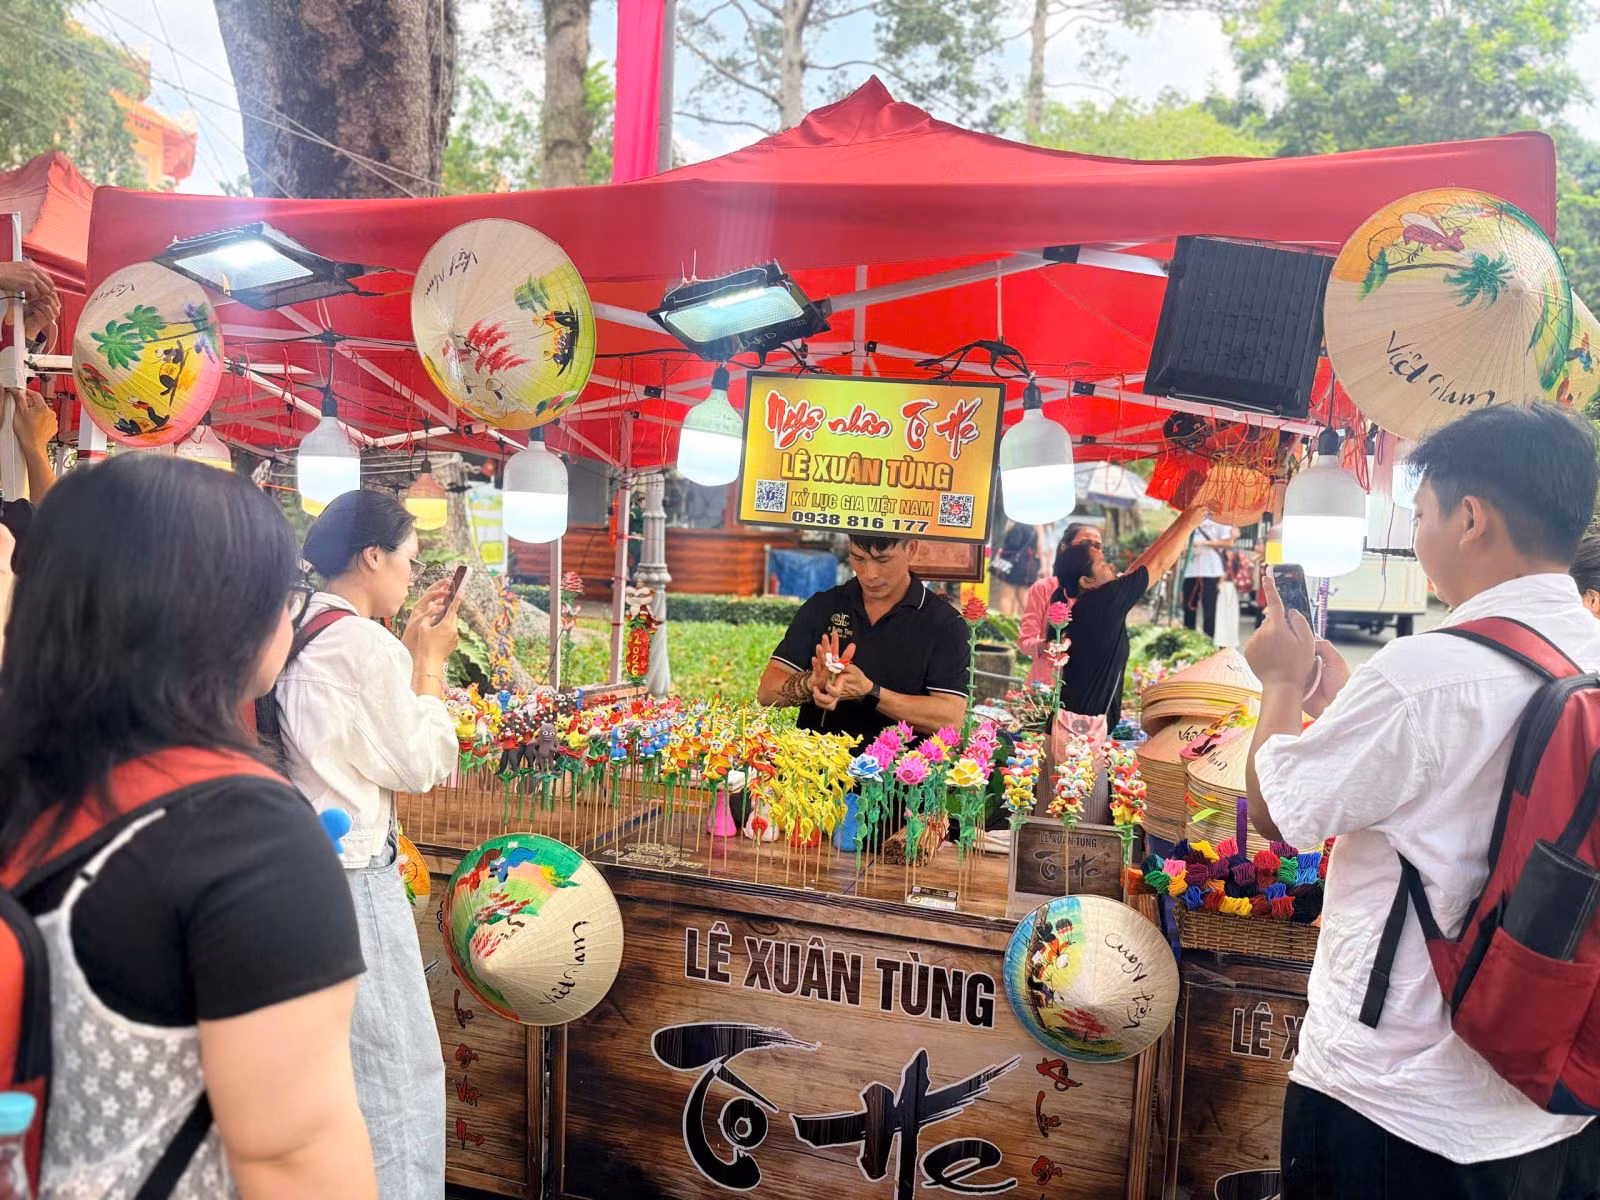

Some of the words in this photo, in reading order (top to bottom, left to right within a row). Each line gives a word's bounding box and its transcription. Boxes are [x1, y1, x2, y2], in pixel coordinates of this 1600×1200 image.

[765, 389, 827, 449] Nghệ
[827, 402, 894, 438] nhân
[780, 448, 811, 481] LÊ
[812, 452, 882, 486] XUÂN
[886, 454, 954, 491] TÙNG
[790, 487, 809, 507] KỶ
[812, 492, 838, 512] LỤC
[841, 495, 865, 512] GIA
[867, 495, 898, 517] VIỆT
[899, 499, 934, 517] NAM
[791, 510, 841, 526] 0938
[846, 514, 884, 529] 816
[892, 518, 930, 533] 177
[685, 921, 732, 985] LÊ
[743, 936, 864, 1006] XUÂN
[874, 951, 998, 1029] TÙNG
[1231, 1001, 1274, 1059] LÊ
